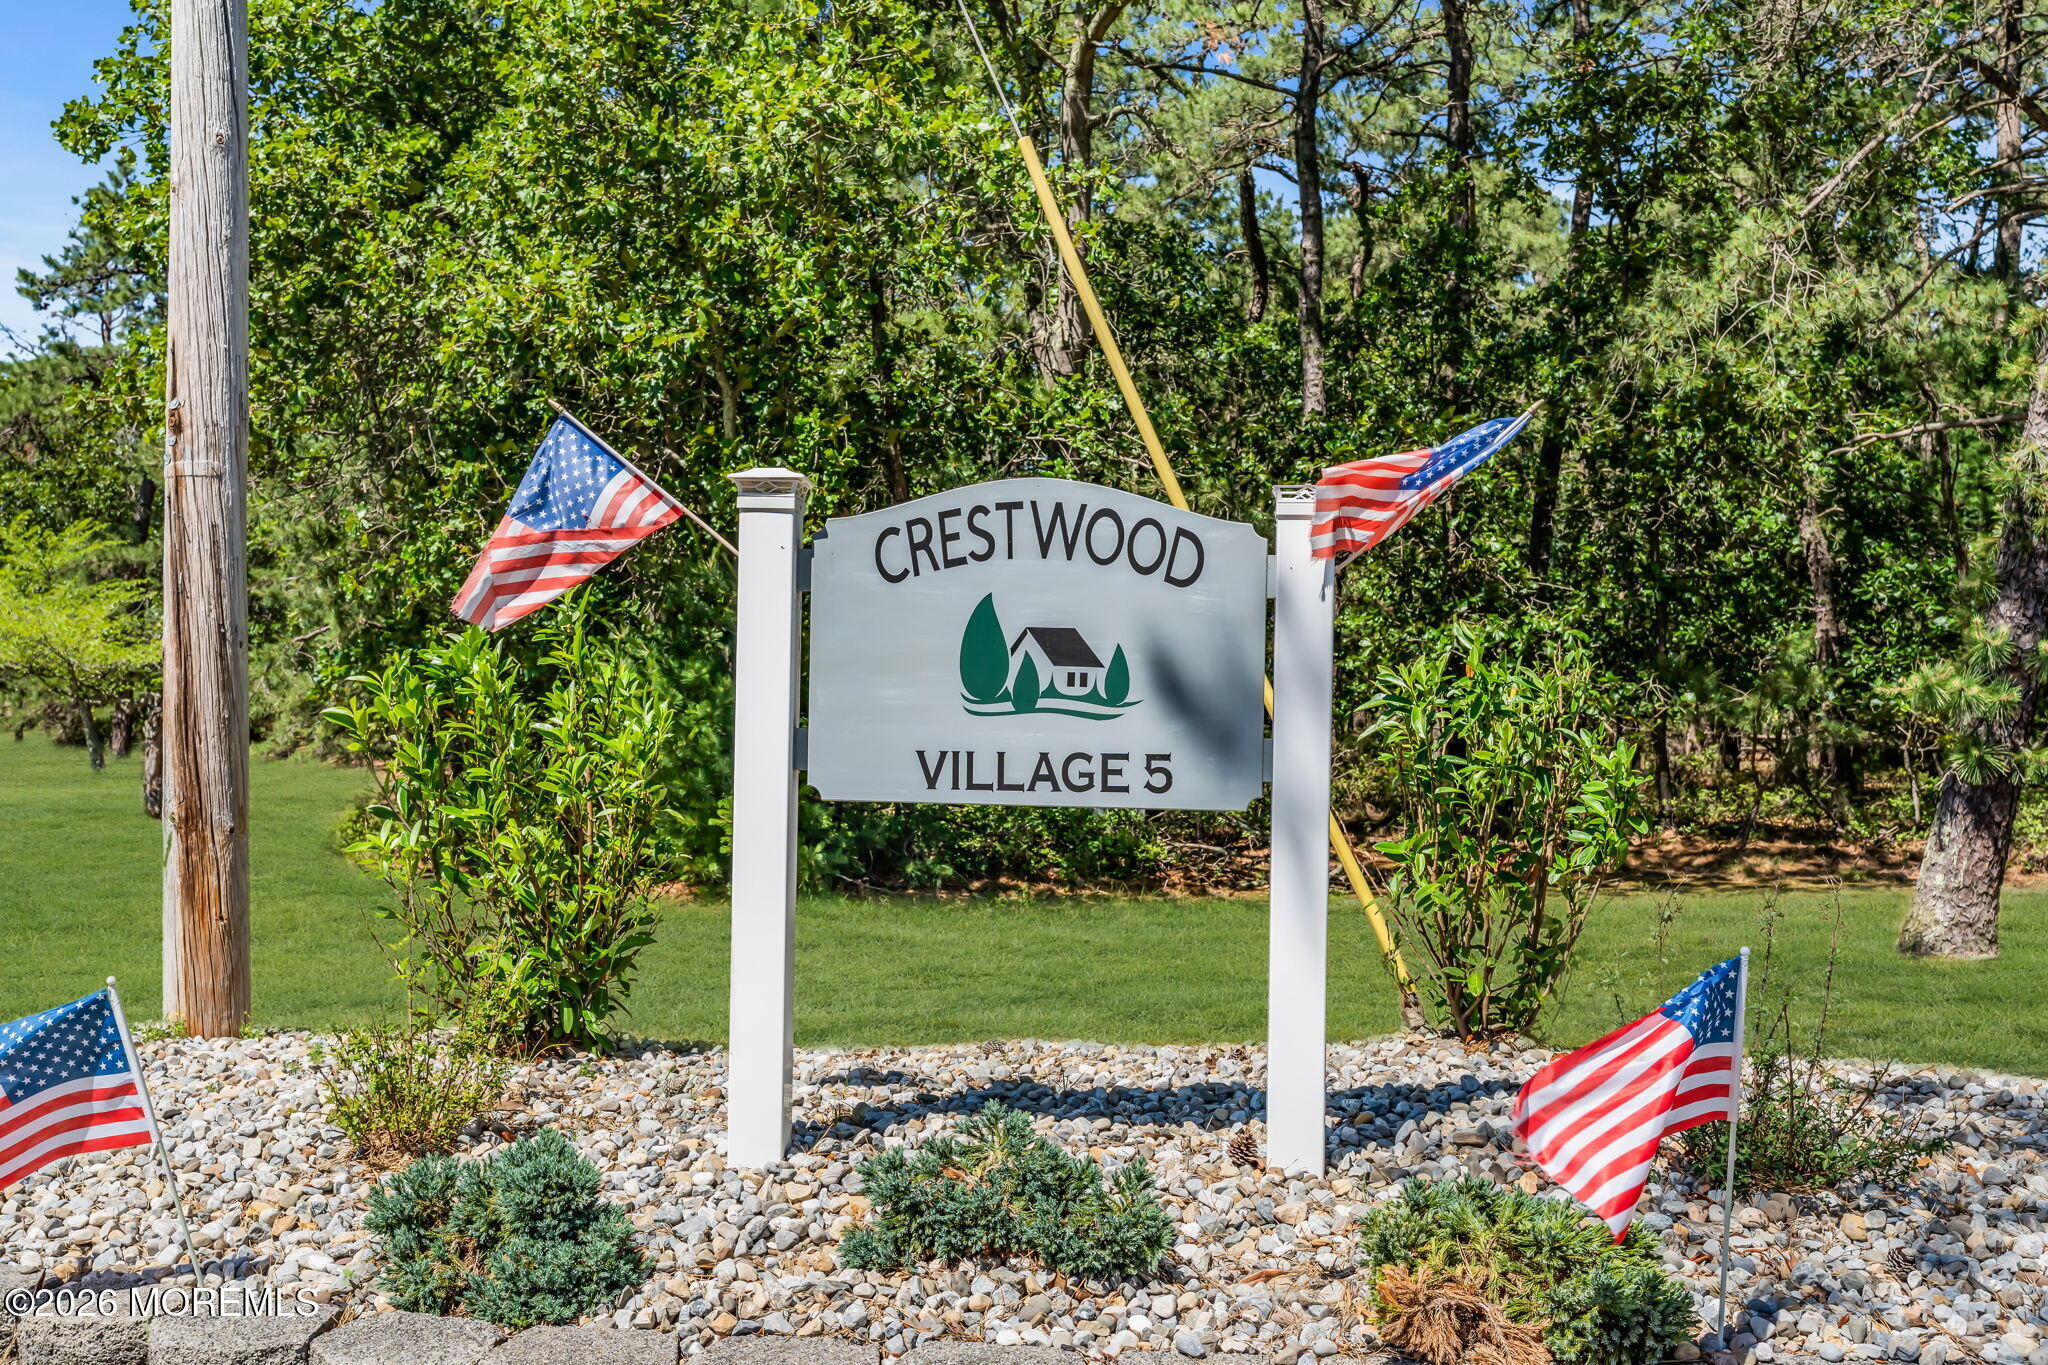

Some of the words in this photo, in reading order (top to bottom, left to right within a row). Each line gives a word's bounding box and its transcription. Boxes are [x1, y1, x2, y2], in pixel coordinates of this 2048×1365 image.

[875, 500, 1205, 588] CRESTWOOD
[915, 750, 1130, 793] VILLAGE
[1143, 752, 1174, 795] 5
